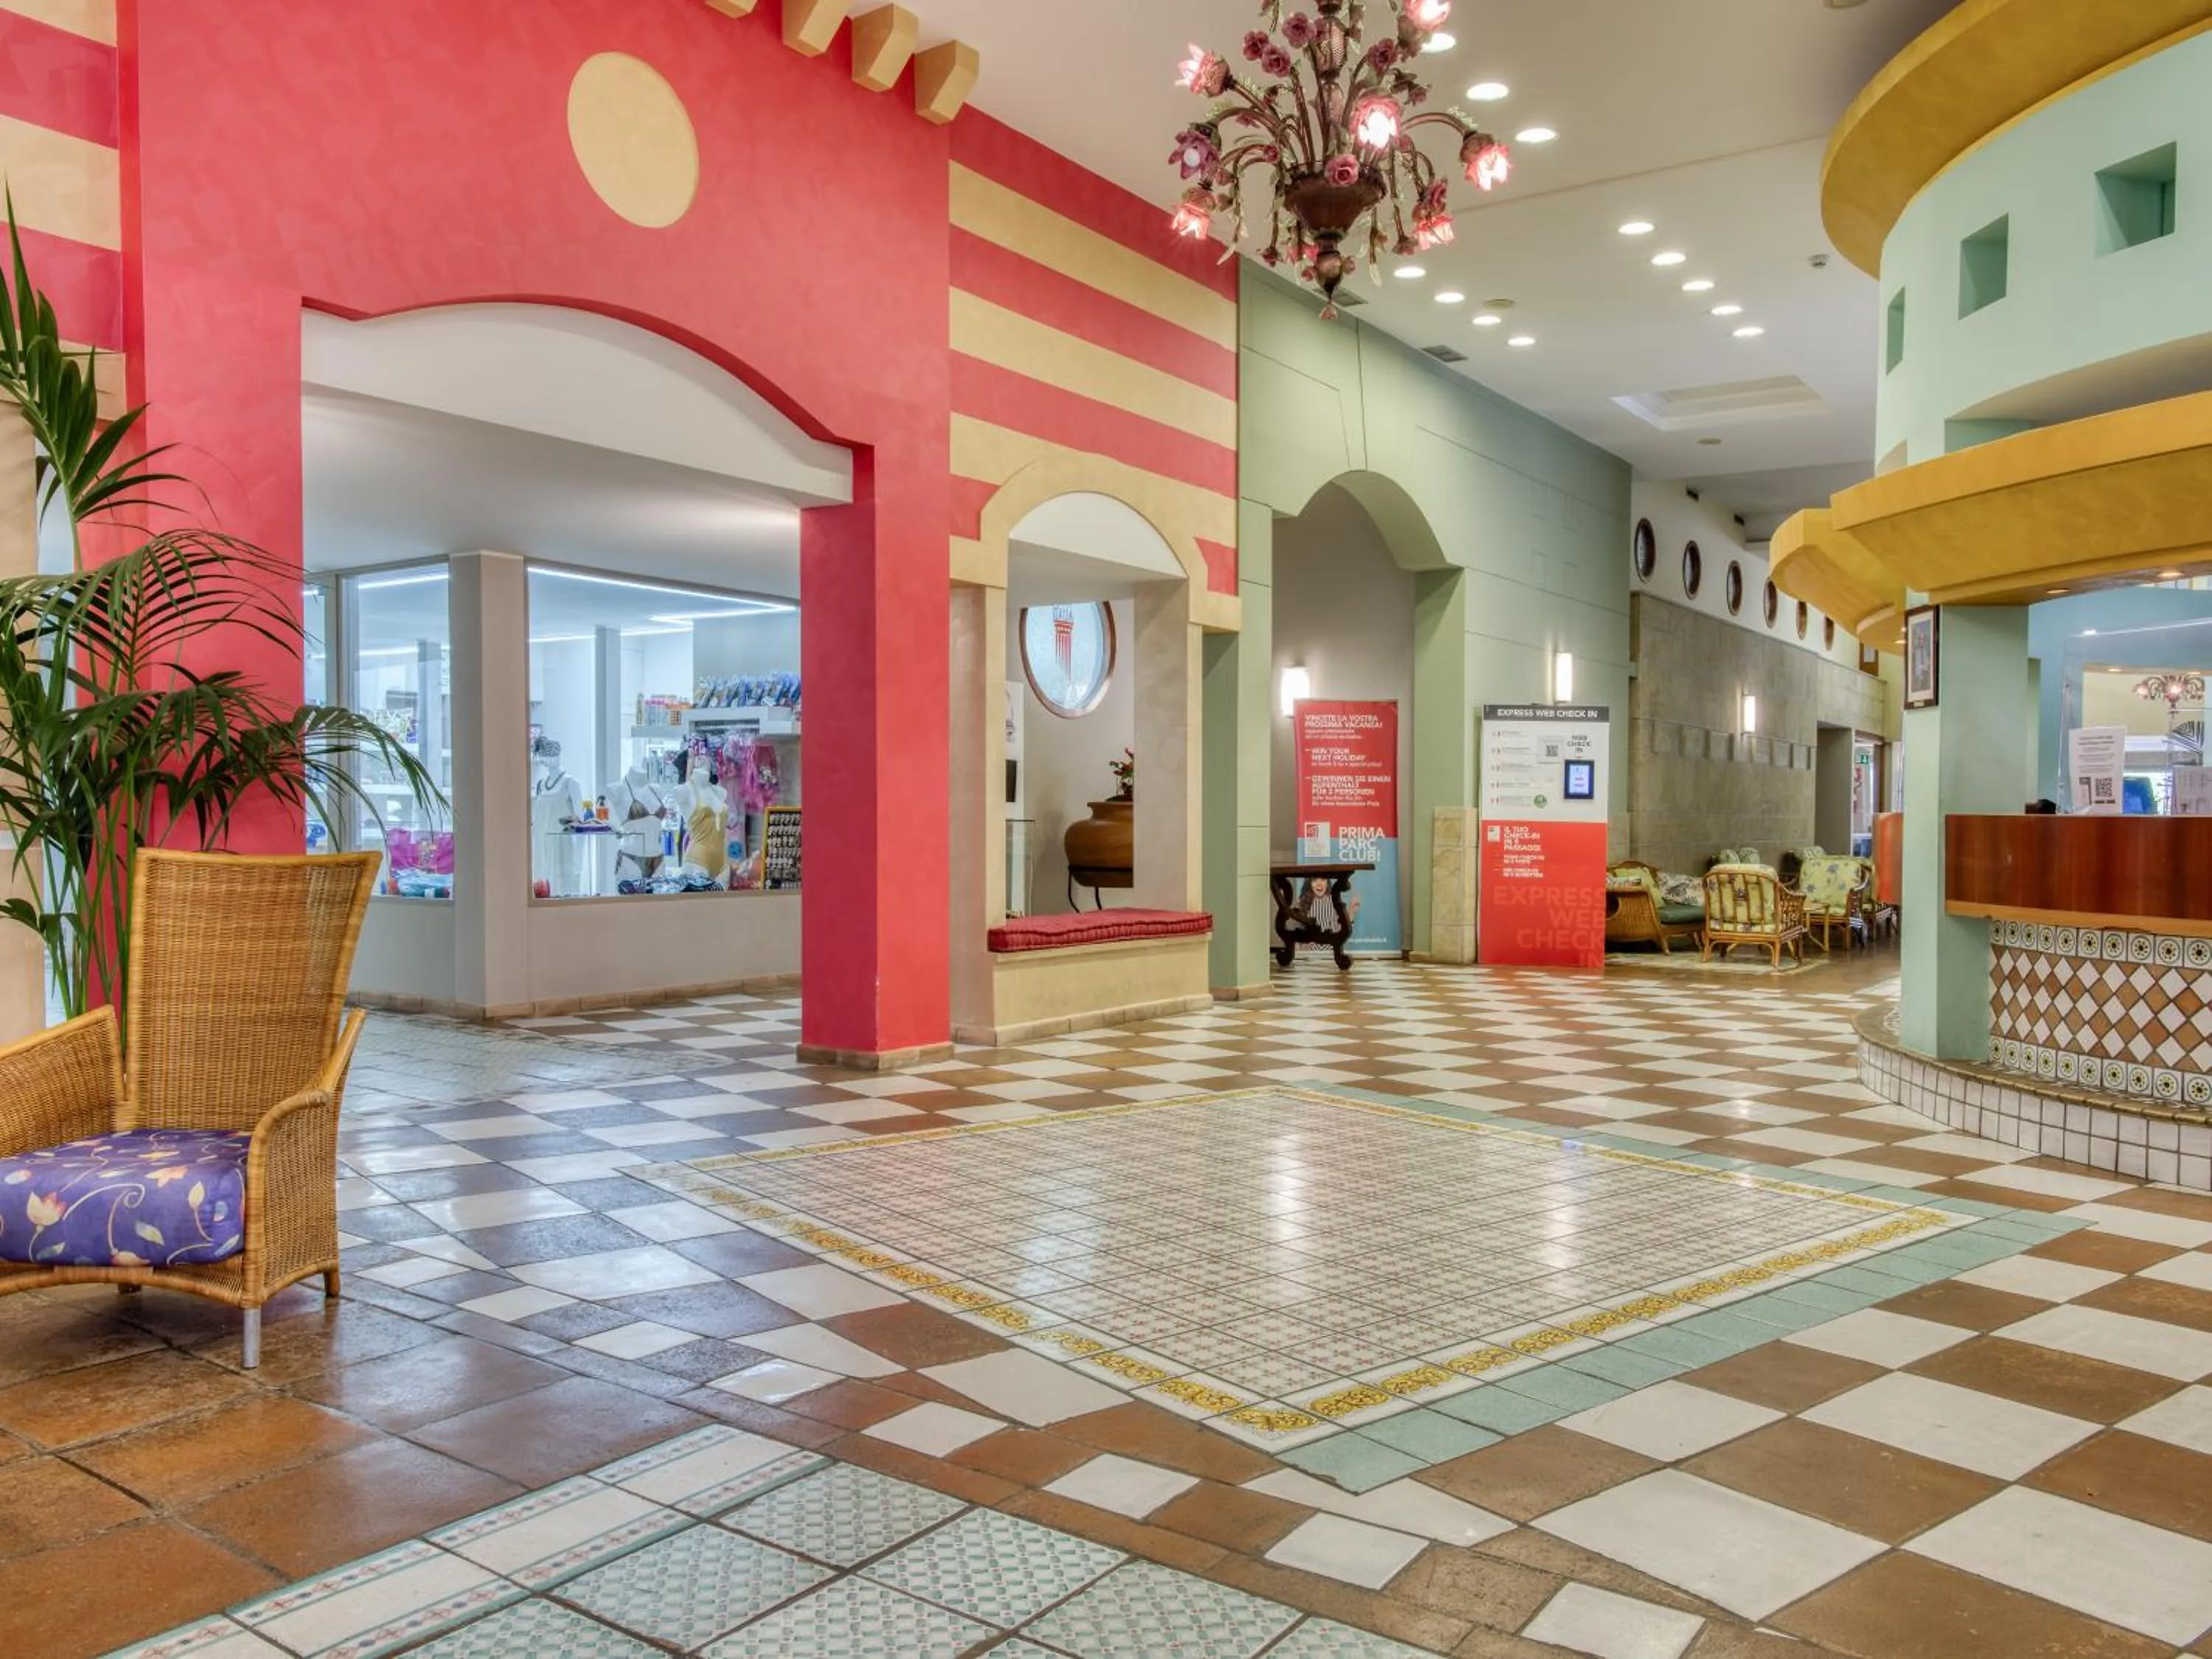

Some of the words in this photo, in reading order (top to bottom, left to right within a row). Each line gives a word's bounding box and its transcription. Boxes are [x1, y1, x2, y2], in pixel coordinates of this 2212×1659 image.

[1498, 709, 1534, 717] EXPRESS
[1536, 709, 1554, 717] WEB
[1557, 710, 1585, 718] CHECK
[1587, 710, 1598, 718] IN
[1338, 827, 1385, 838] PRIMA
[1338, 838, 1377, 850] PARC
[1339, 849, 1381, 861] CLUB!
[1493, 886, 1606, 908] EXPRESS
[1516, 929, 1604, 950] CHECK
